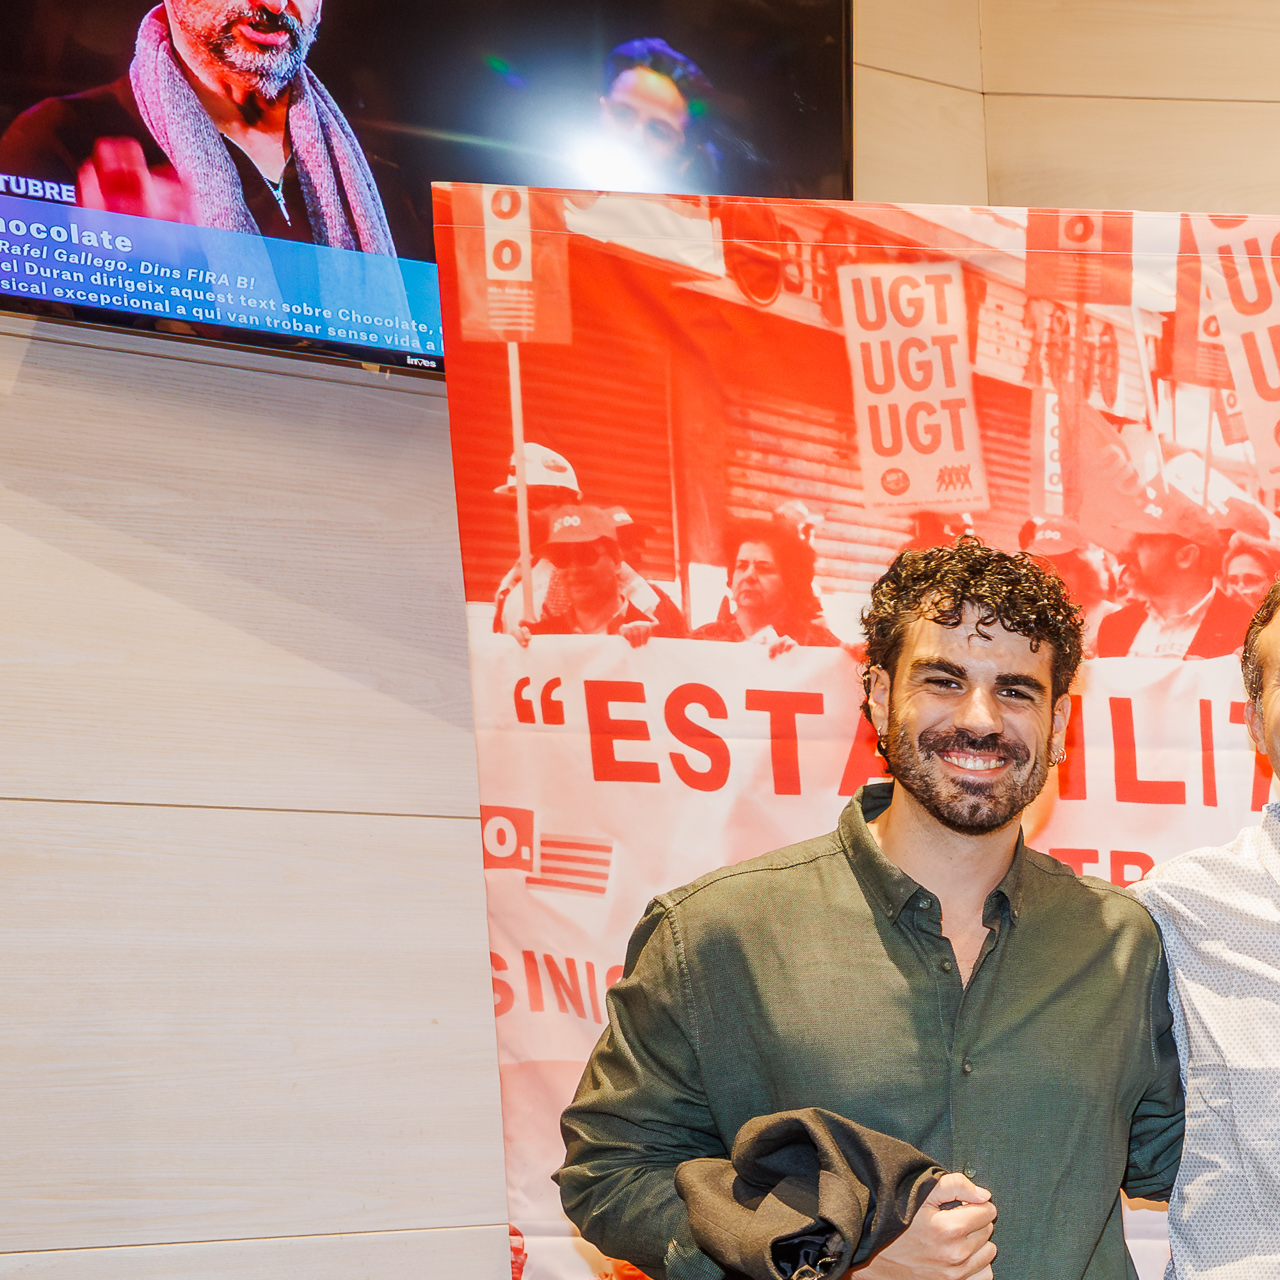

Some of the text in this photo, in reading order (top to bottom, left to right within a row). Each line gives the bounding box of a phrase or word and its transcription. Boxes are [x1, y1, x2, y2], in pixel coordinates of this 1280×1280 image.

[0, 240, 256, 290] Rafel Gallego. Dins FIRA B!
[0, 277, 47, 295] sical
[53, 286, 170, 313] excepcional
[176, 304, 186, 315] a
[192, 306, 222, 321] qui
[227, 312, 260, 326] van
[265, 315, 322, 334] trobar
[327, 326, 379, 342] sense
[384, 333, 421, 349] vida
[425, 340, 436, 351] a
[24, 261, 84, 282] Duran
[90, 271, 165, 295] dirigeix
[170, 286, 235, 305] aquest
[239, 294, 276, 311] text
[281, 302, 332, 319] sobre
[338, 308, 433, 335] Chocolate,
[851, 274, 953, 331] UGT
[406, 355, 436, 368] inves
[859, 334, 958, 395] UGT
[867, 398, 967, 457] UGT
[490, 950, 624, 1025] SINI
